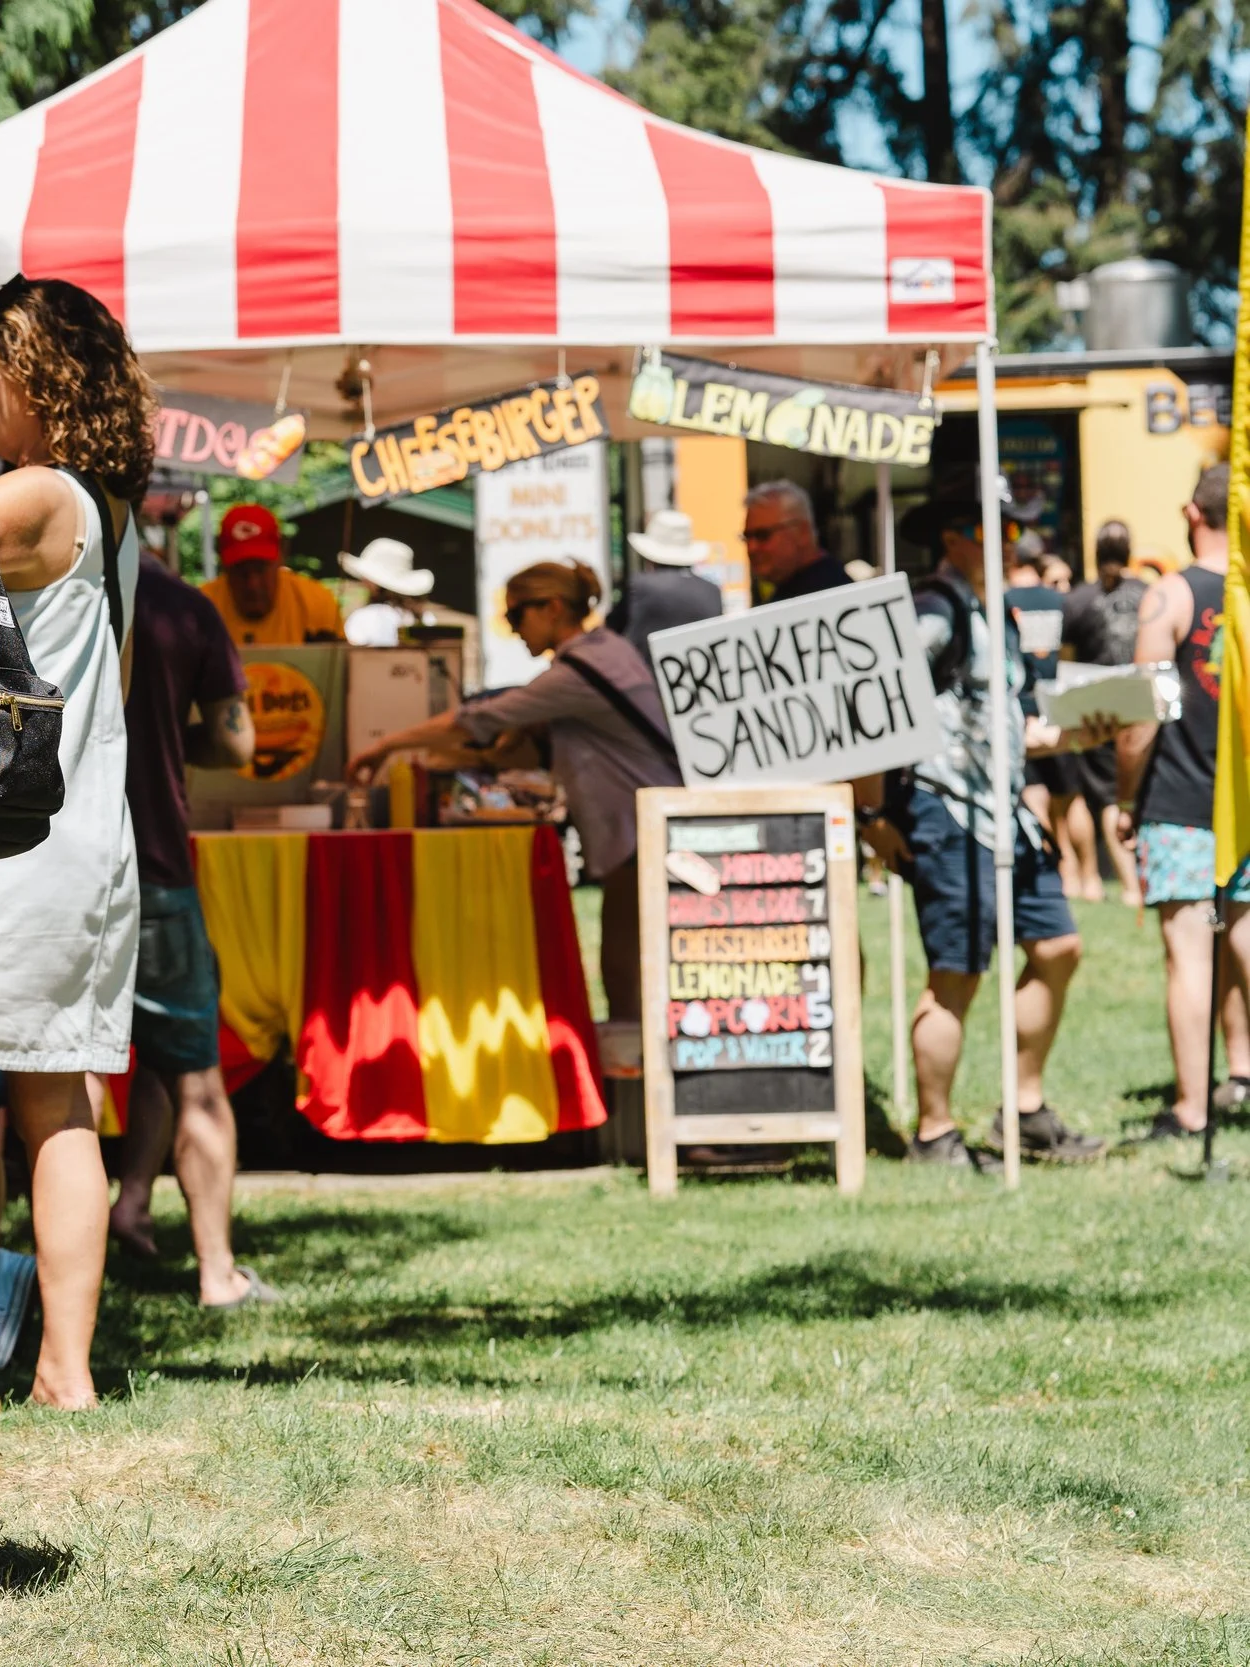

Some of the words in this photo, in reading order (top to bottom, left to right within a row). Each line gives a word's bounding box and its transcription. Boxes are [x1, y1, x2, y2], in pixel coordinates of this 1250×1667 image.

[351, 376, 603, 497] CHEESEBURGER
[669, 378, 935, 465] LEMONADE
[660, 596, 905, 715] BREAKFAST
[689, 669, 915, 778] SANDWICH
[803, 848, 826, 883] 5
[804, 889, 826, 917] 7
[669, 962, 803, 999] LEMONADE
[802, 963, 831, 1000] 4
[808, 992, 833, 1029] 5
[676, 1037, 723, 1068] POP
[808, 1030, 833, 1067] 2
